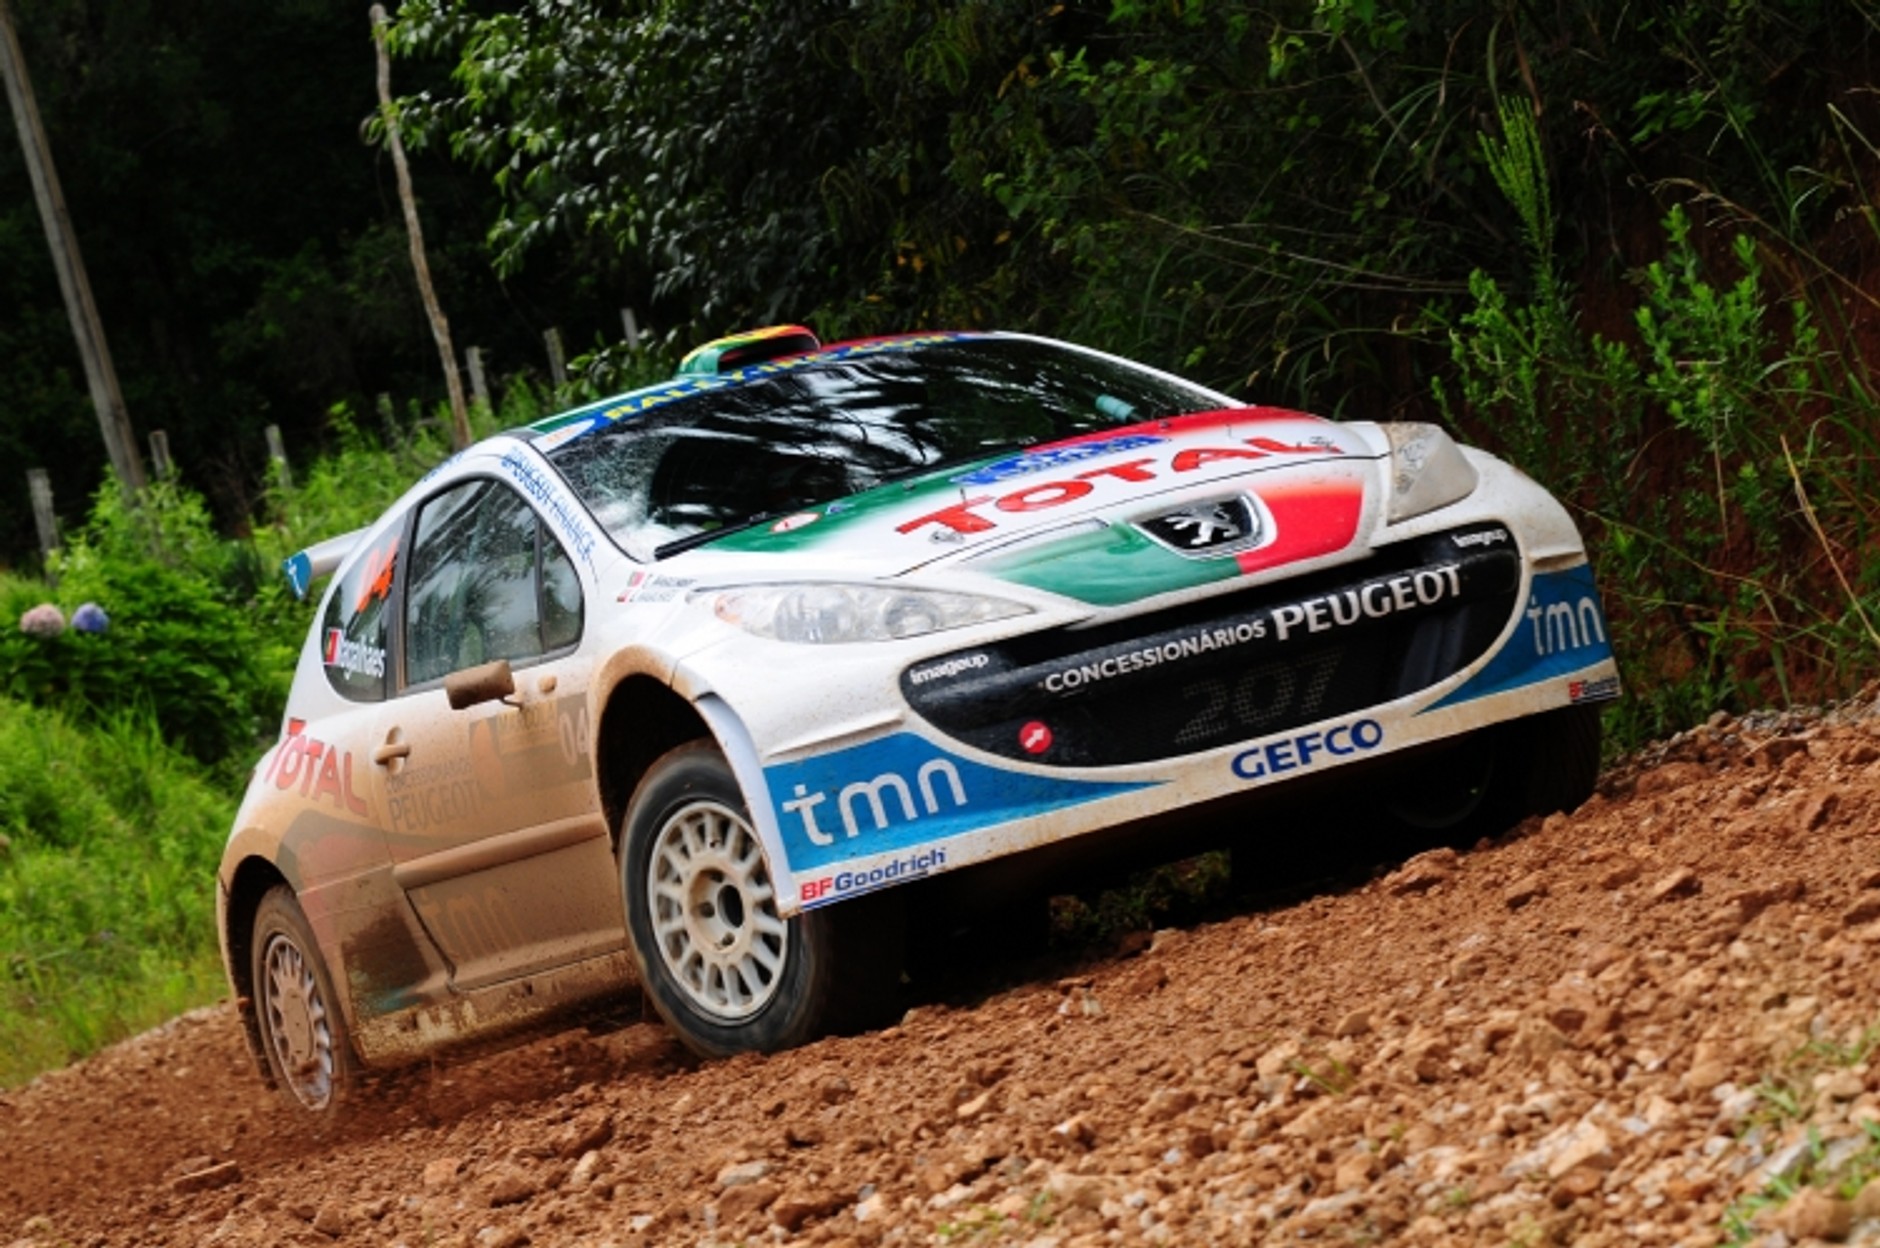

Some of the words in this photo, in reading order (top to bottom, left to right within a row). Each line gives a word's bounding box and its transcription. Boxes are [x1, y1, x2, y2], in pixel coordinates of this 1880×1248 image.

[895, 436, 1346, 535] TOTAL
[1044, 619, 1266, 693] CONCESSIONÁRIOS
[1271, 563, 1462, 641] PEUGEOT
[1526, 594, 1606, 656] tmn
[1174, 648, 1344, 745] 207
[264, 718, 368, 817] TOTAL
[1230, 718, 1384, 780] GEFCO
[783, 757, 969, 847] tmn
[800, 846, 947, 903] BFGoodrich
